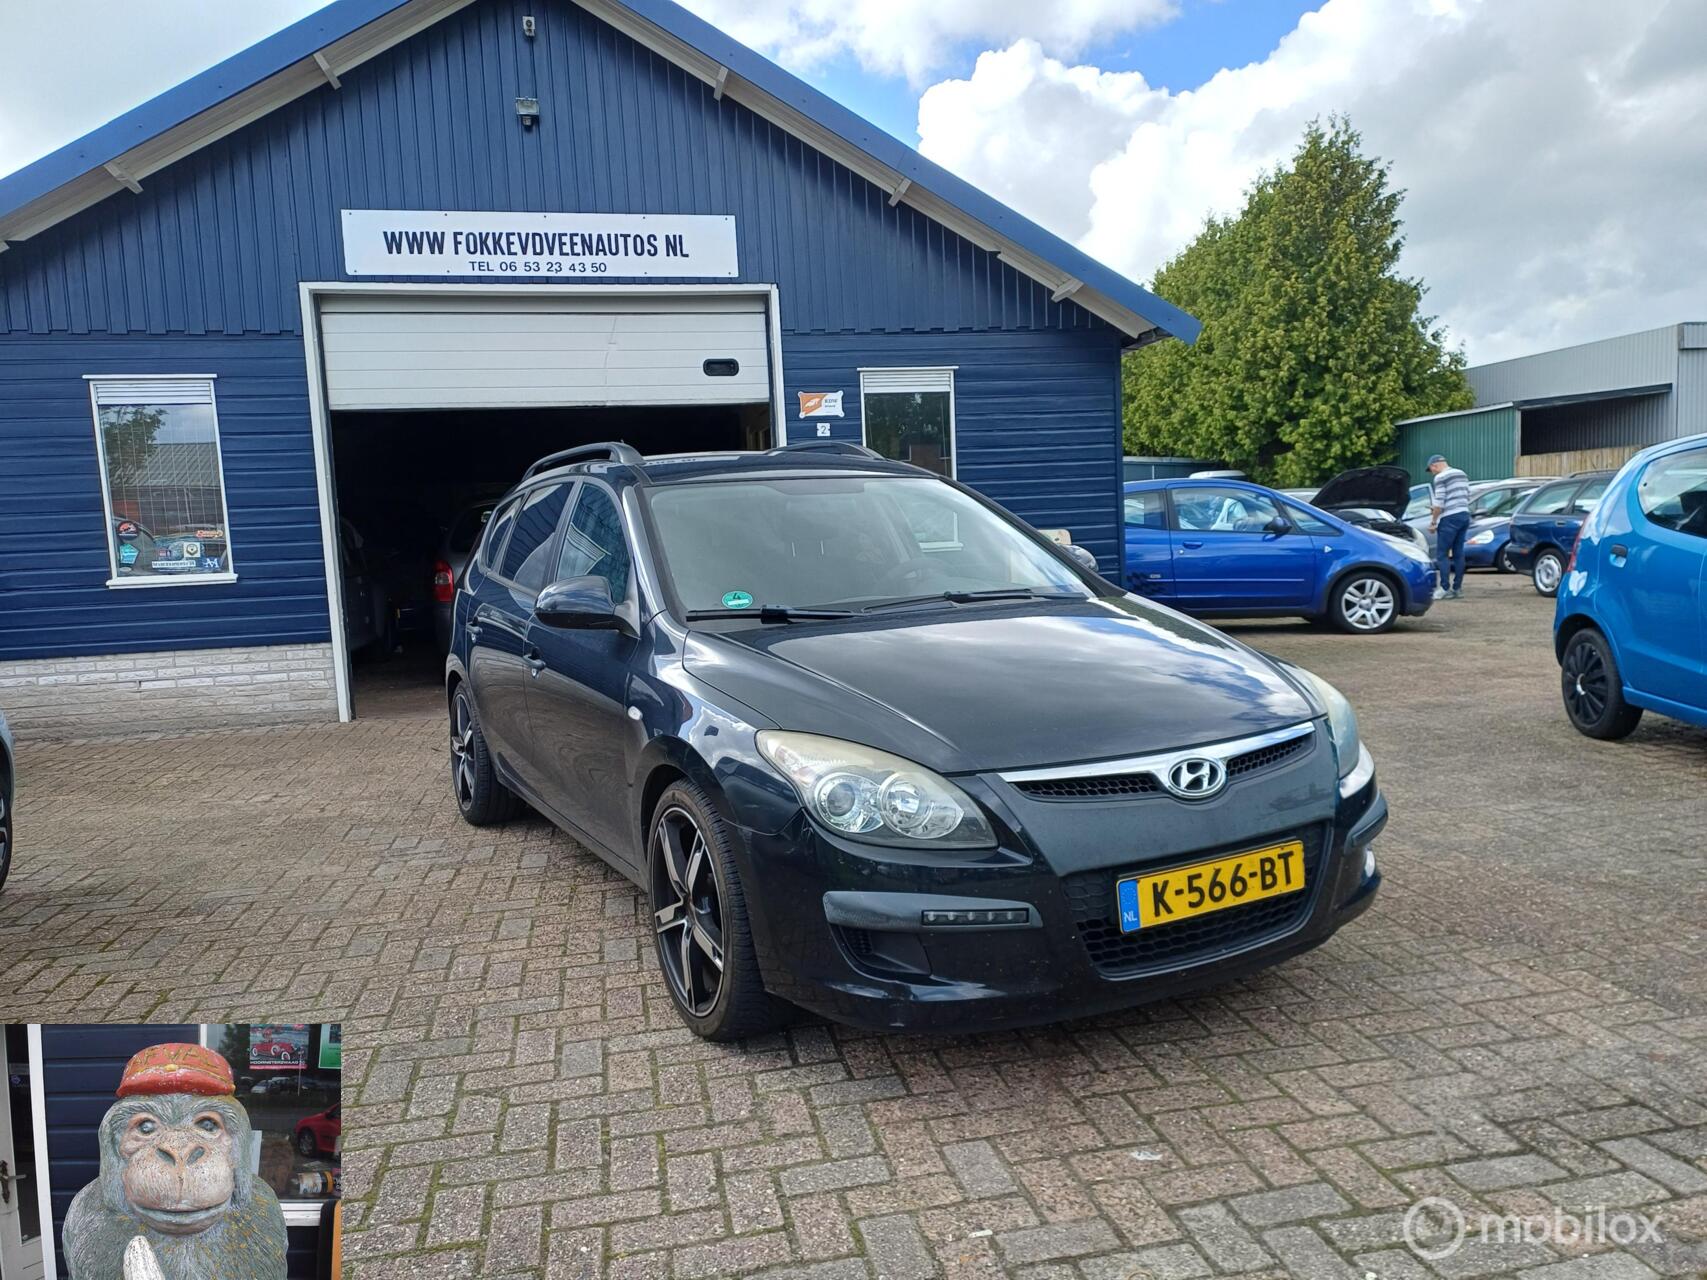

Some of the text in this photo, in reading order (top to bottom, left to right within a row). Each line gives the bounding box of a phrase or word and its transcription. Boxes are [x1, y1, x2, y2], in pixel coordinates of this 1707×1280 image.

[383, 231, 689, 258] WWW FOKKEVDVEENAUTOS NL
[469, 261, 607, 273] TEL 06 53 23 43 50
[820, 425, 827, 434] 2
[1152, 850, 1295, 918] K-566-BT
[1123, 911, 1138, 924] NL
